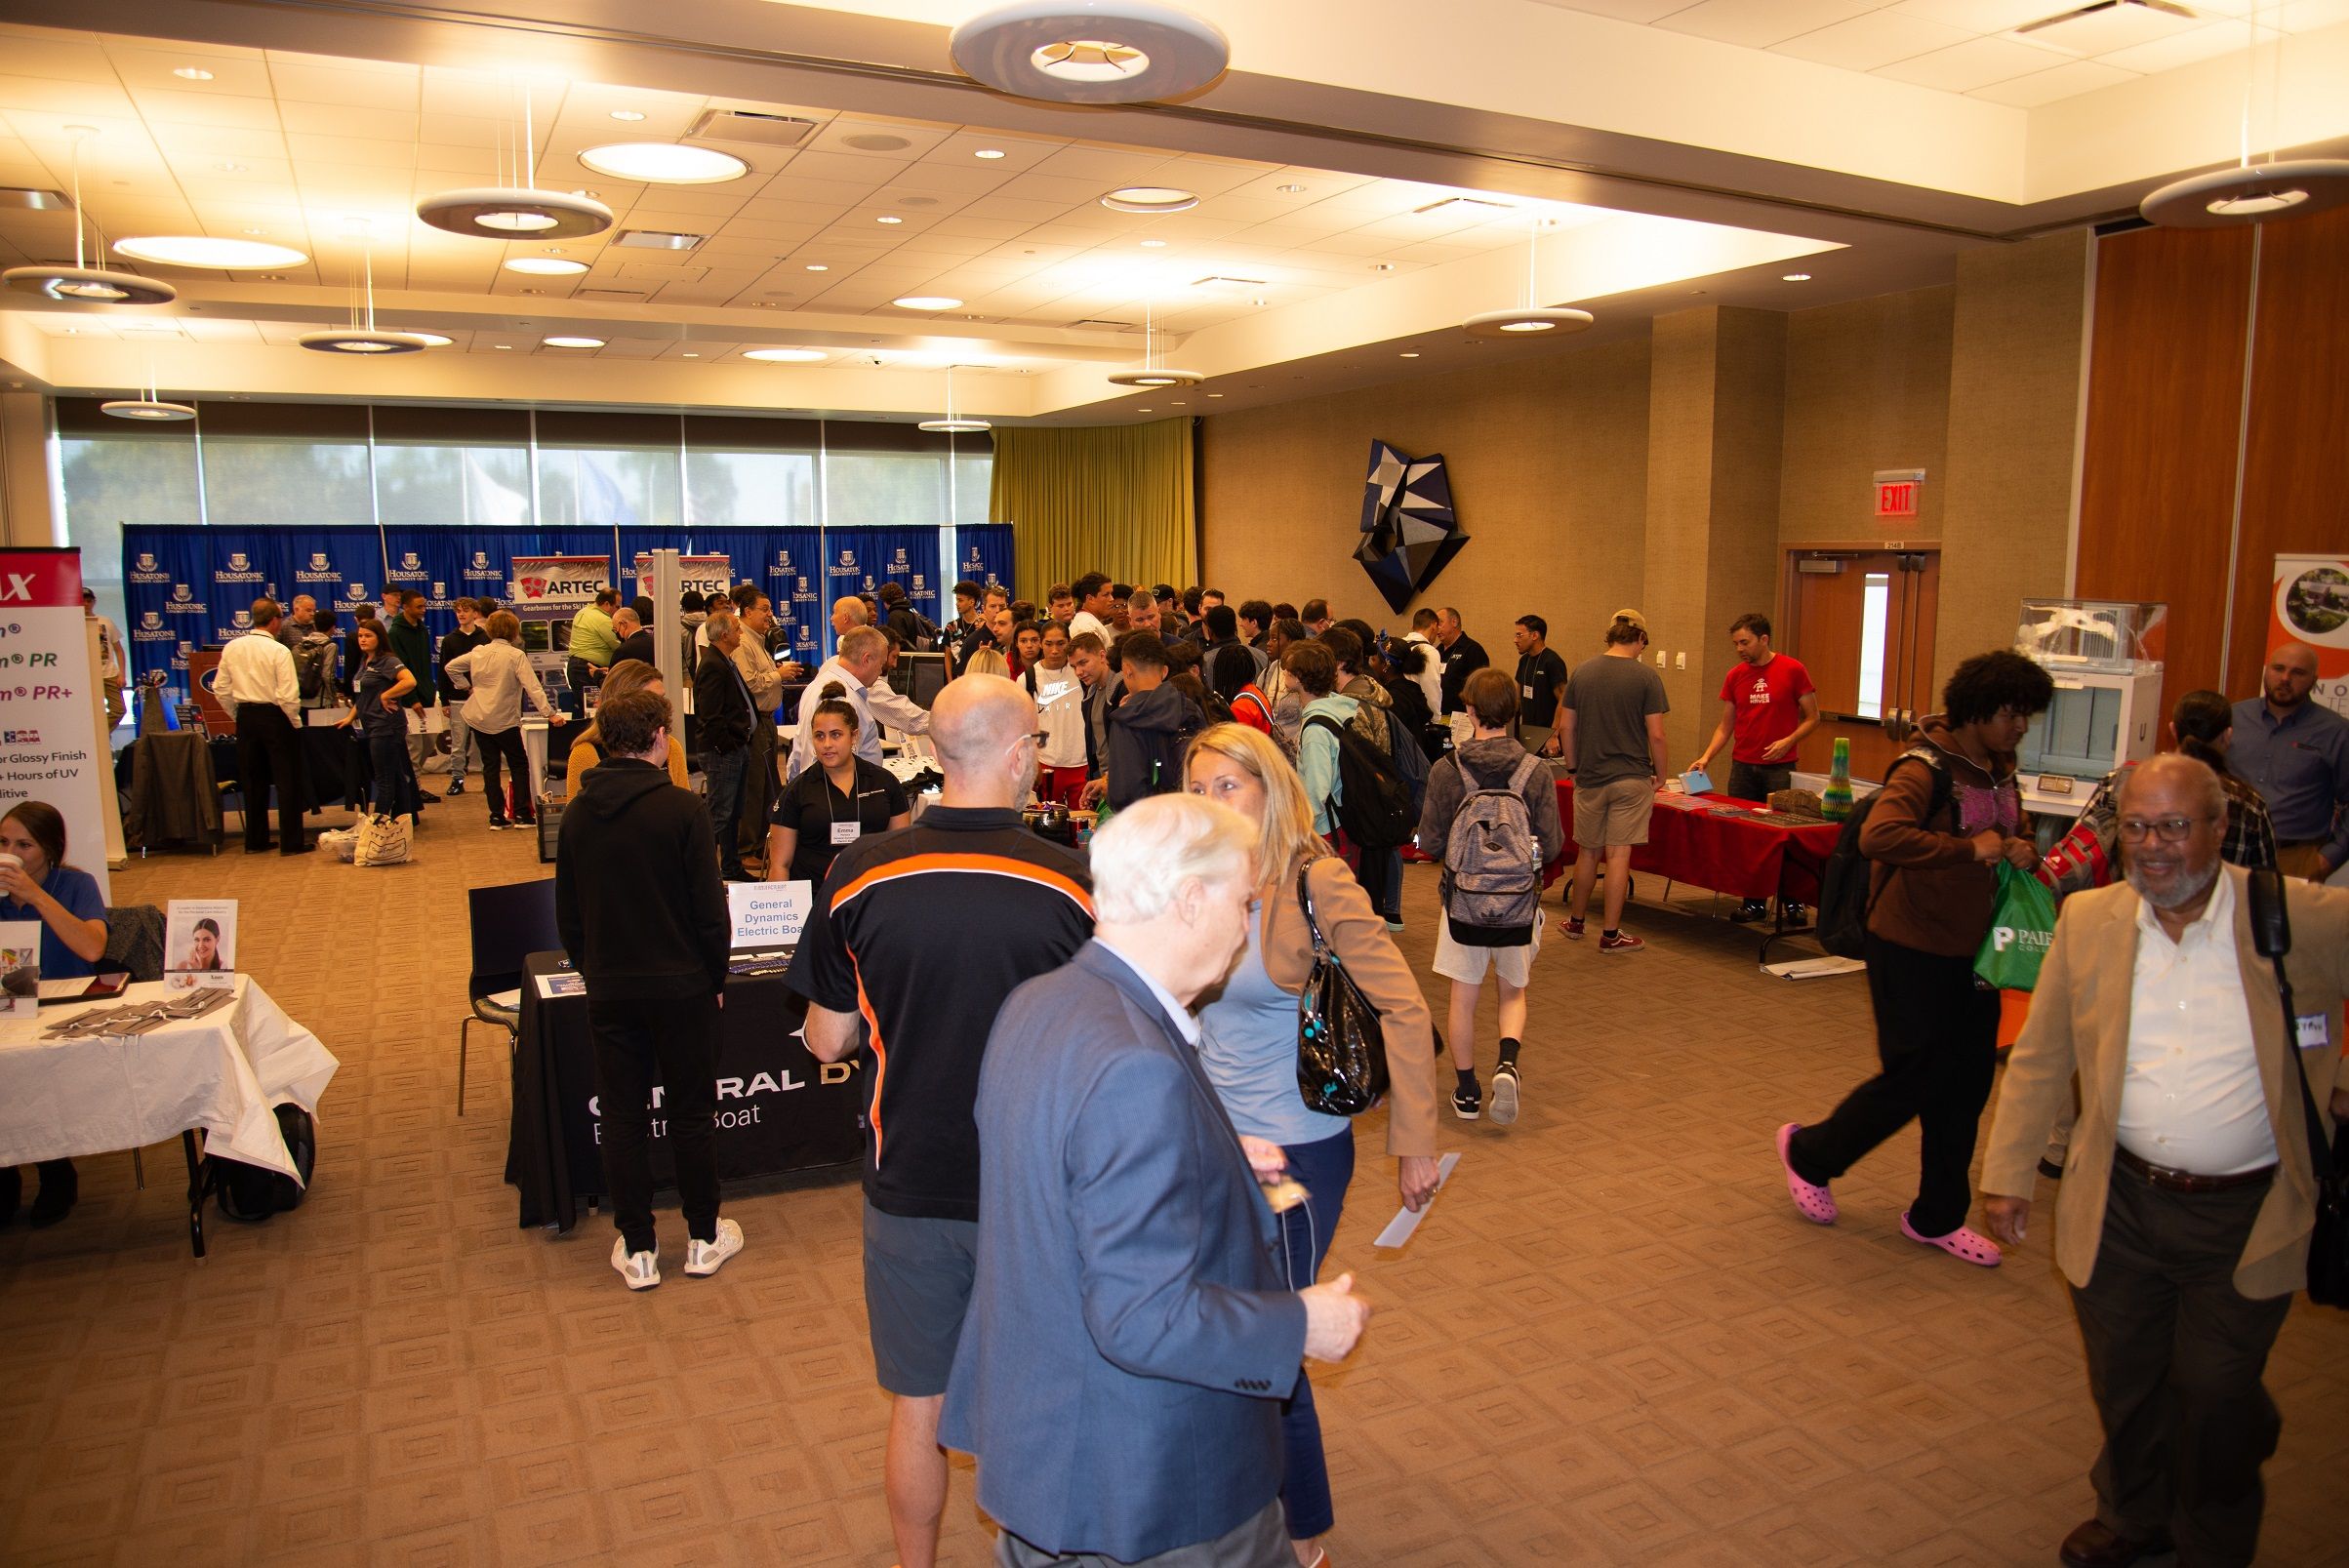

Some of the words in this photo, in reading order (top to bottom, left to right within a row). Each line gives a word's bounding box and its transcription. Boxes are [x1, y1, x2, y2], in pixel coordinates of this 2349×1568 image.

[1882, 484, 1912, 512] EXIT
[215, 571, 264, 580] HOUSATONIC
[0, 574, 36, 601] X
[547, 580, 604, 594] ARTEC
[679, 581, 724, 592] RTEC
[29, 653, 58, 667] PR
[32, 685, 72, 701] PR+
[1042, 680, 1070, 697] NIKE
[1045, 703, 1071, 712] AIR
[4, 729, 41, 744] USA
[10, 752, 49, 765] Glossy
[52, 749, 87, 762] Finish
[7, 771, 44, 781] Hours
[45, 768, 59, 780] of
[60, 768, 79, 779] UV
[749, 899, 792, 909] General
[745, 912, 798, 925] Dynamics
[737, 926, 779, 937] Electric
